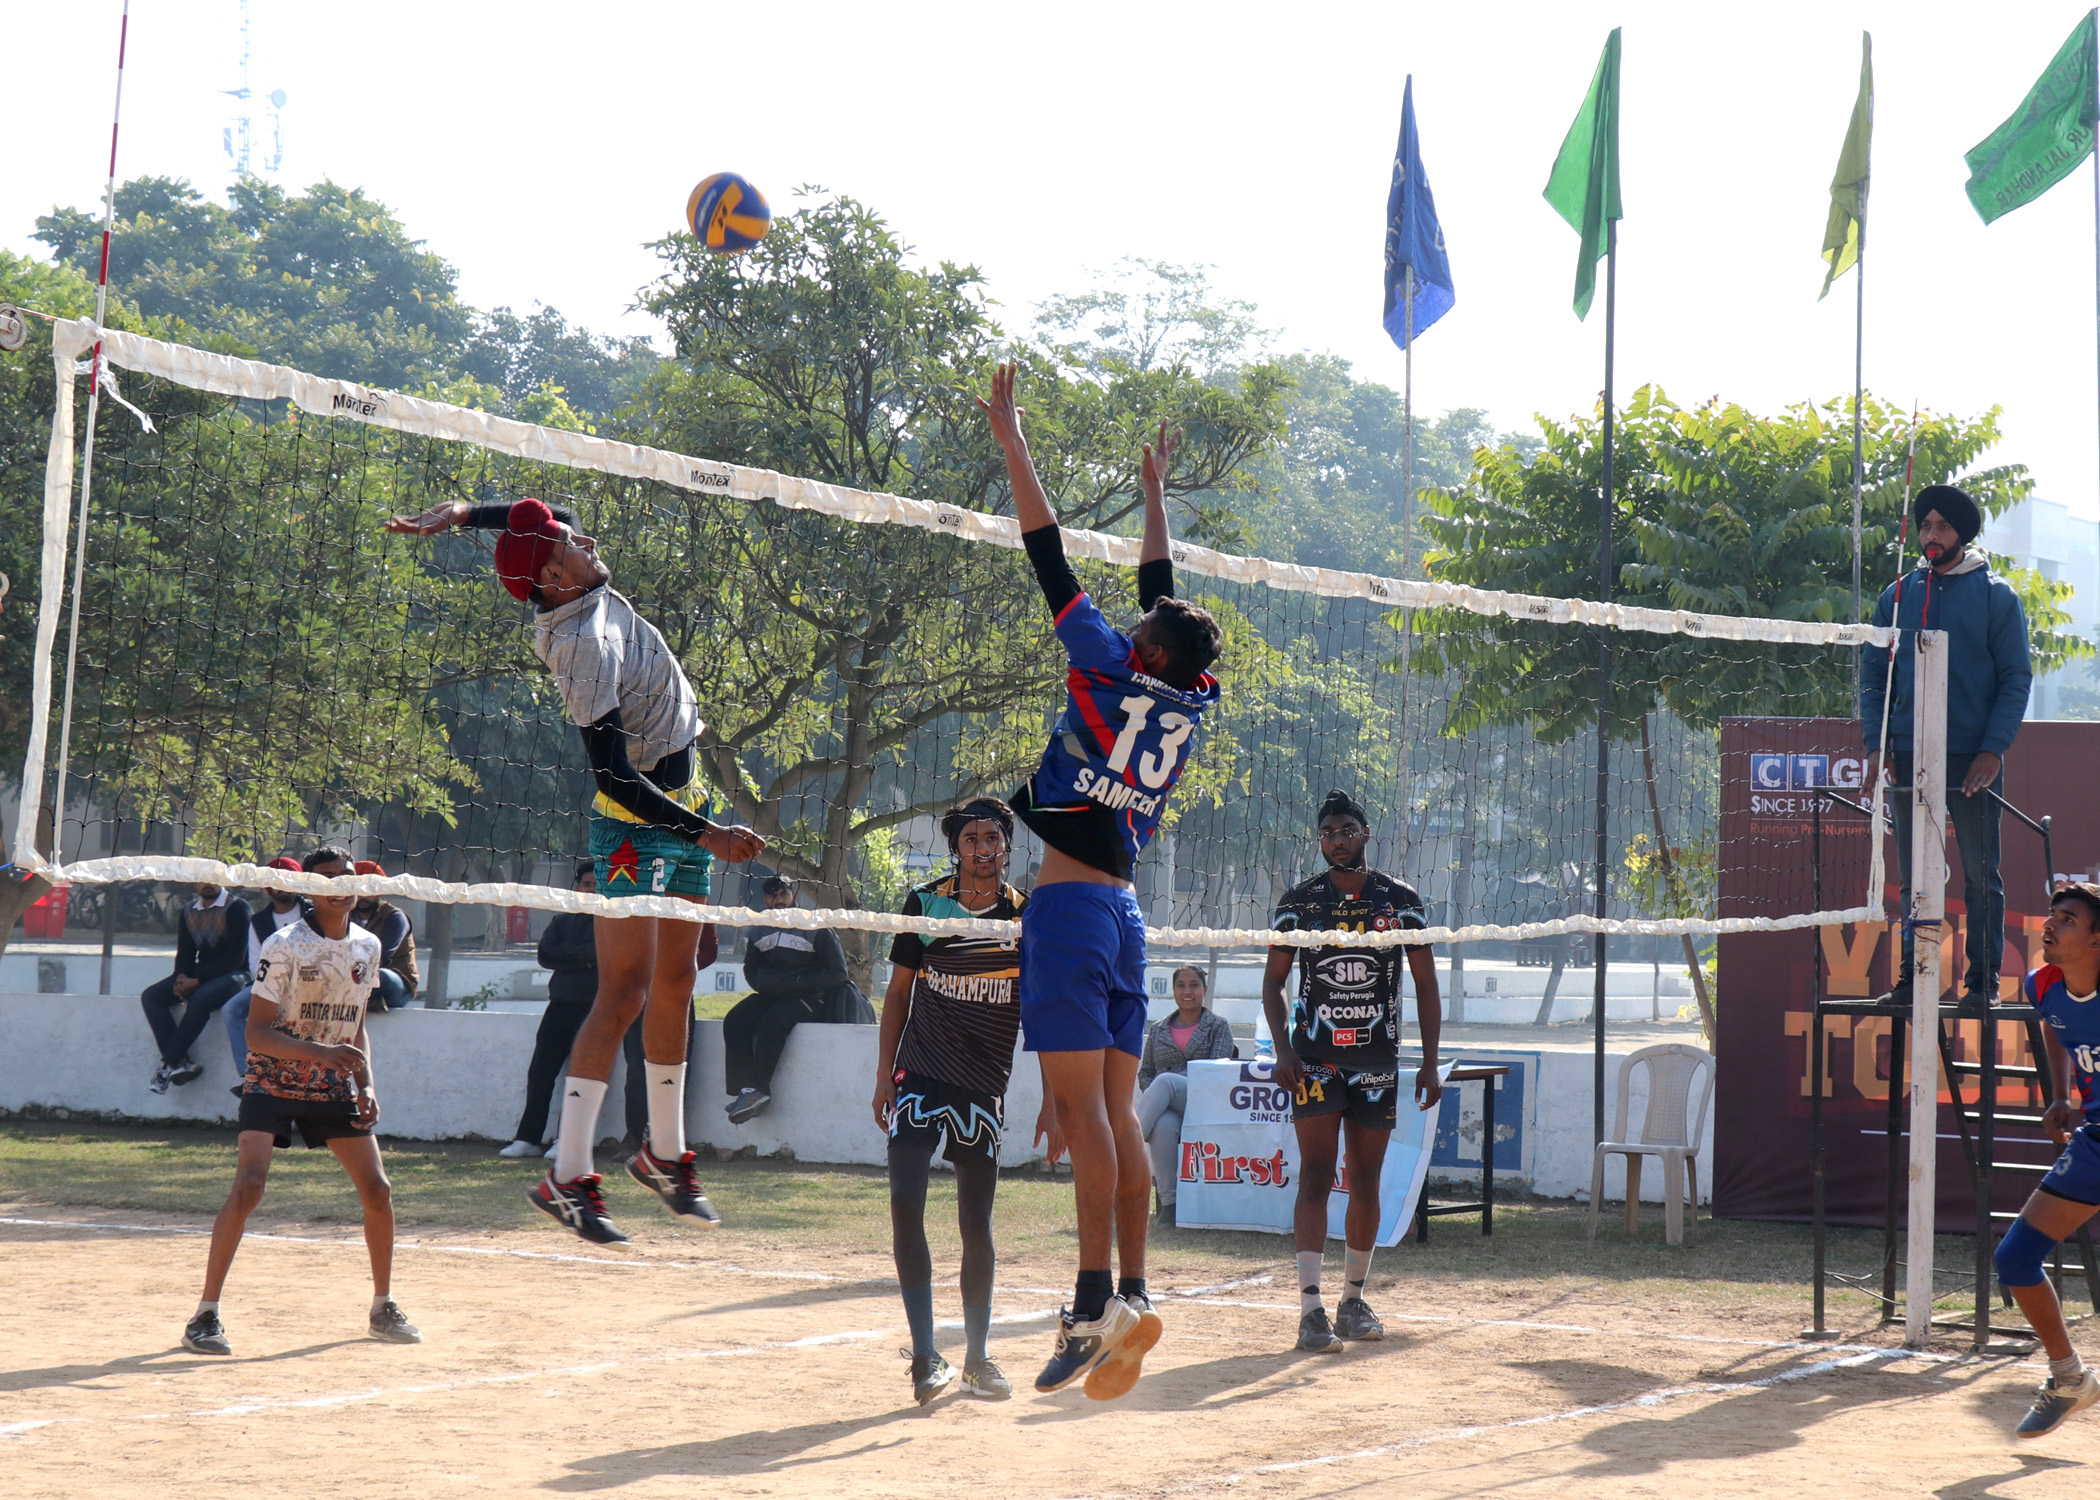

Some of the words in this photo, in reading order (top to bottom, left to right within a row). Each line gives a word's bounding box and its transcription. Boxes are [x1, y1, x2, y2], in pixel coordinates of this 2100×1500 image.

[333, 393, 377, 417] Montex
[690, 470, 730, 487] Montex
[1106, 694, 1195, 789] 13
[1757, 757, 1821, 788] CT
[1750, 795, 1796, 813] SINCE
[1750, 822, 1798, 838] Running
[1801, 824, 1871, 838] Pr-Nursery
[651, 857, 666, 893] 2
[1334, 962, 1368, 982] SIR
[1329, 991, 1349, 1001] Safety
[1350, 990, 1375, 1001] Perugia
[1336, 1033, 1352, 1041] PCS
[1229, 1085, 1290, 1112] GRO
[1295, 1079, 1326, 1106] 04
[1249, 1112, 1282, 1123] SINCE
[1283, 1113, 1295, 1124] 19
[1179, 1140, 1290, 1189] First
